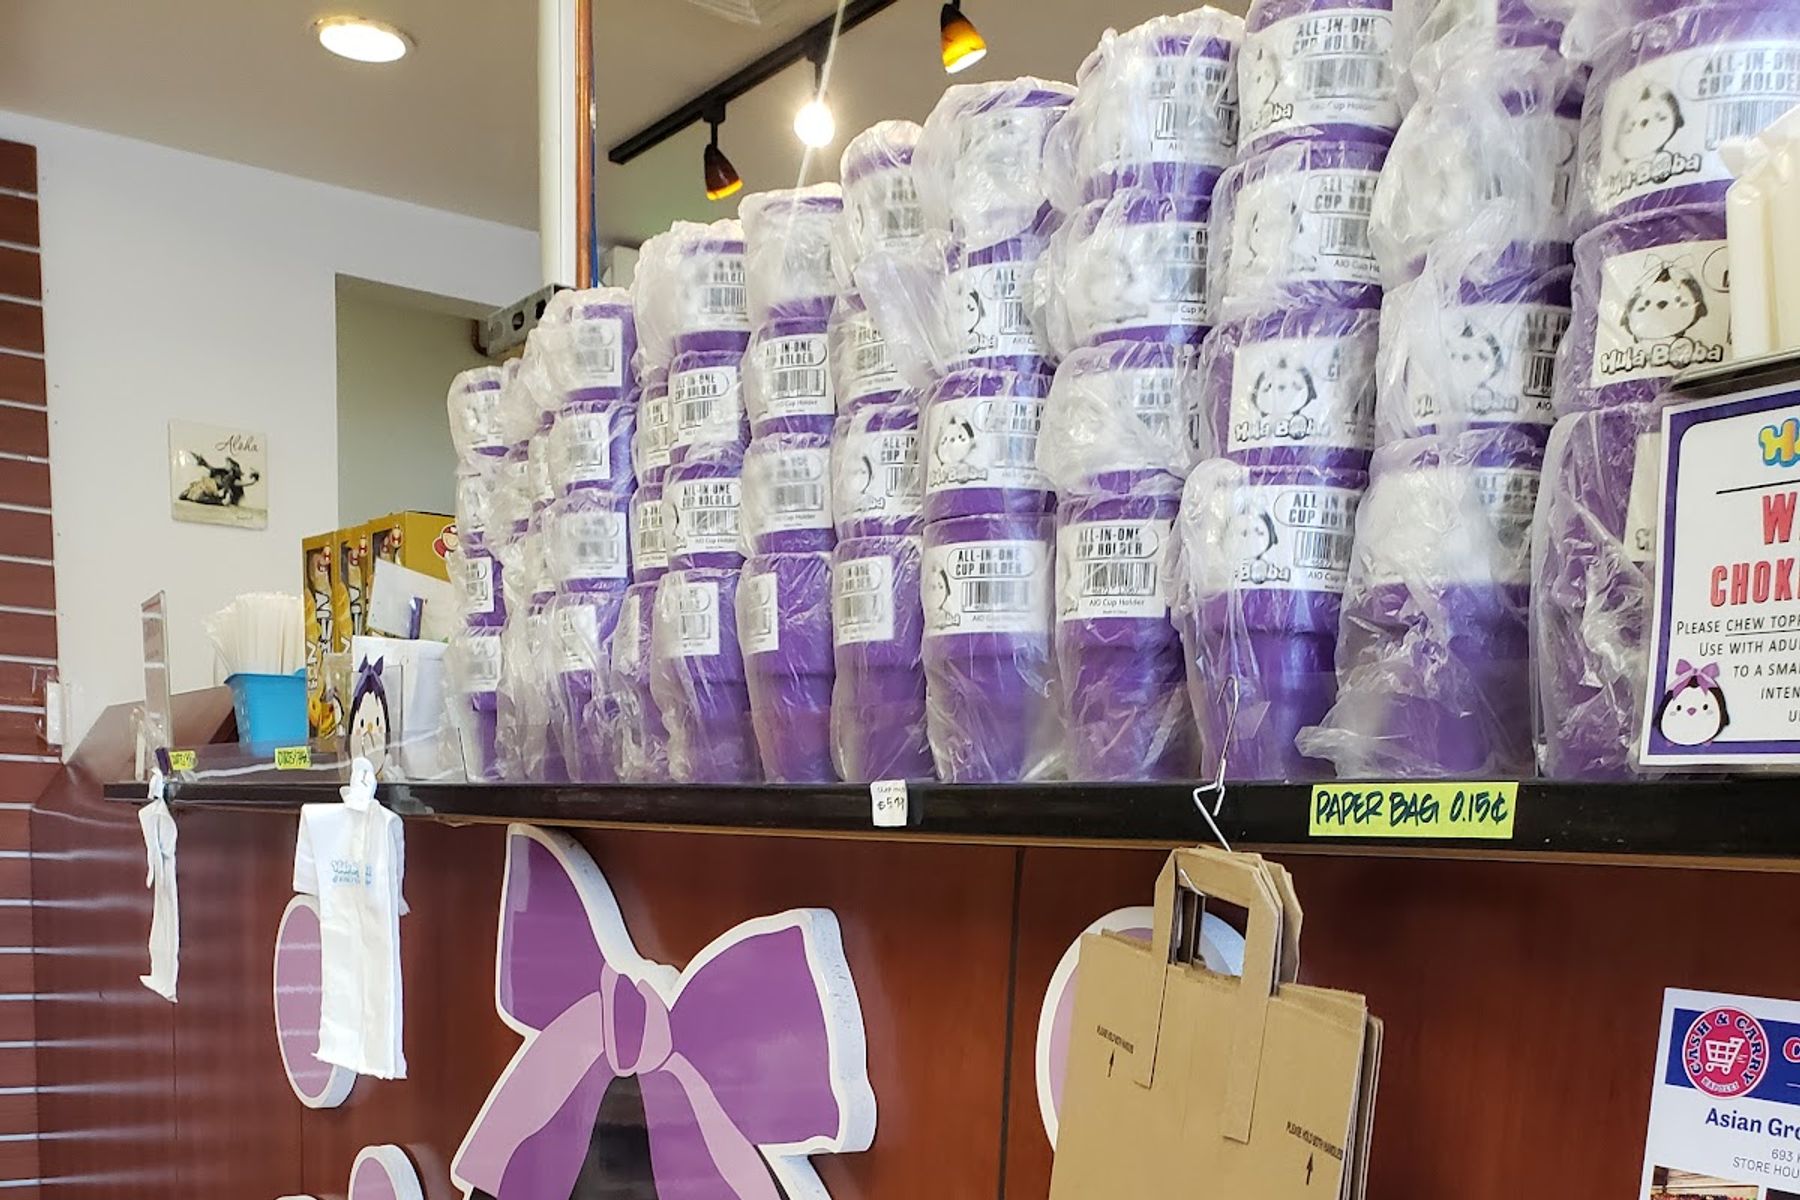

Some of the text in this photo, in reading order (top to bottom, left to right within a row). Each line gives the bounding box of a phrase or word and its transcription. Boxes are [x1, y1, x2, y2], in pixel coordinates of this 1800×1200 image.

[1703, 52, 1800, 74] ALL-IN-ON
[1698, 71, 1800, 96] CUP HOLDE
[1314, 195, 1342, 209] CUP
[214, 434, 258, 456] Aloha
[1758, 417, 1800, 468] H
[1288, 509, 1316, 524] CUP
[1098, 541, 1143, 556] HOLDER
[955, 563, 975, 576] CUP
[1710, 557, 1800, 607] CHOK
[1676, 620, 1722, 636] PLEASE
[1726, 616, 1765, 632] CHEW
[1729, 640, 1764, 655] WITH
[1768, 638, 1800, 652] ADU
[1733, 662, 1800, 678] TO A SMA
[1316, 790, 1384, 826] PAPER
[1389, 791, 1440, 827] BAG
[1687, 1011, 1765, 1086] CASH & CARRY
[1705, 1106, 1762, 1134] Asian
[1732, 1156, 1771, 1174] STORE
[1771, 1148, 1794, 1163] 693
